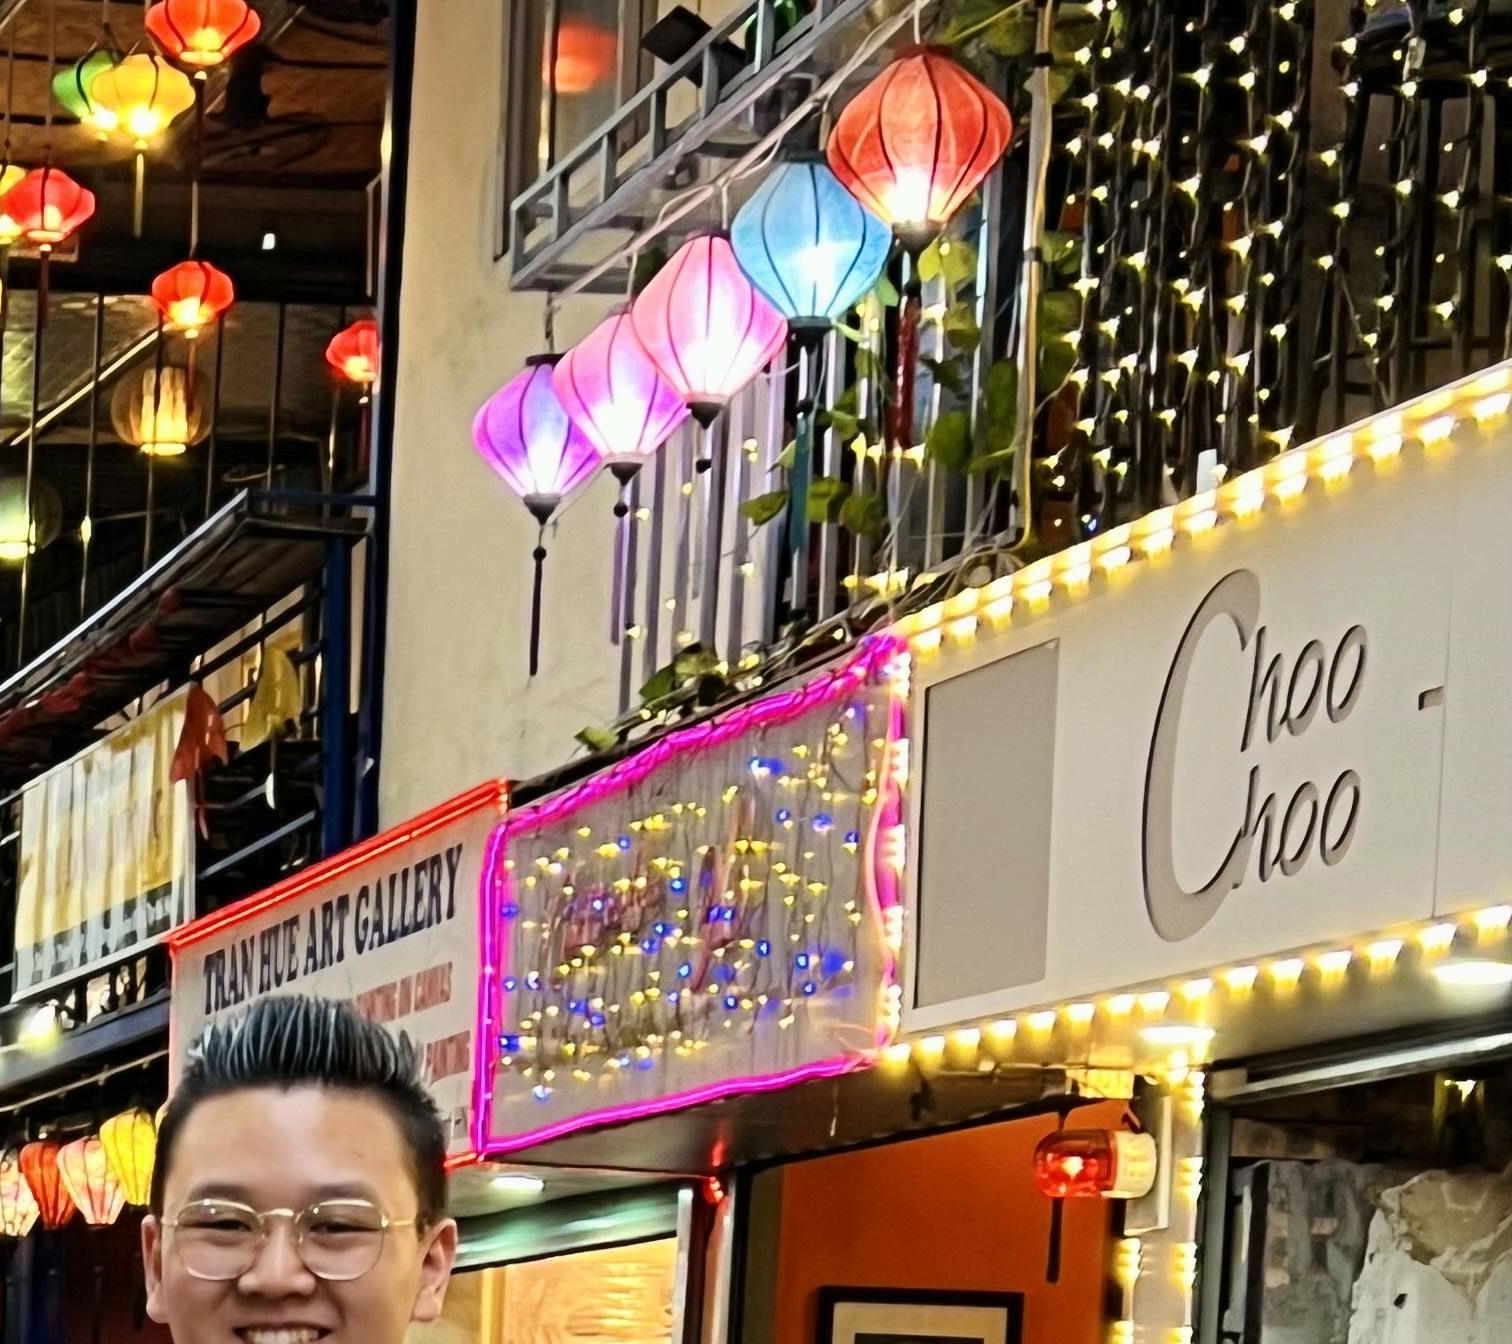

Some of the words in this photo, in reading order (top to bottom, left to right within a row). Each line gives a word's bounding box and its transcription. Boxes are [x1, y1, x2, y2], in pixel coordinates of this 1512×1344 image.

[203, 935, 255, 1015] TRAN
[259, 914, 300, 994] HUE
[303, 893, 350, 976] ART
[354, 843, 464, 955] GALLERY
